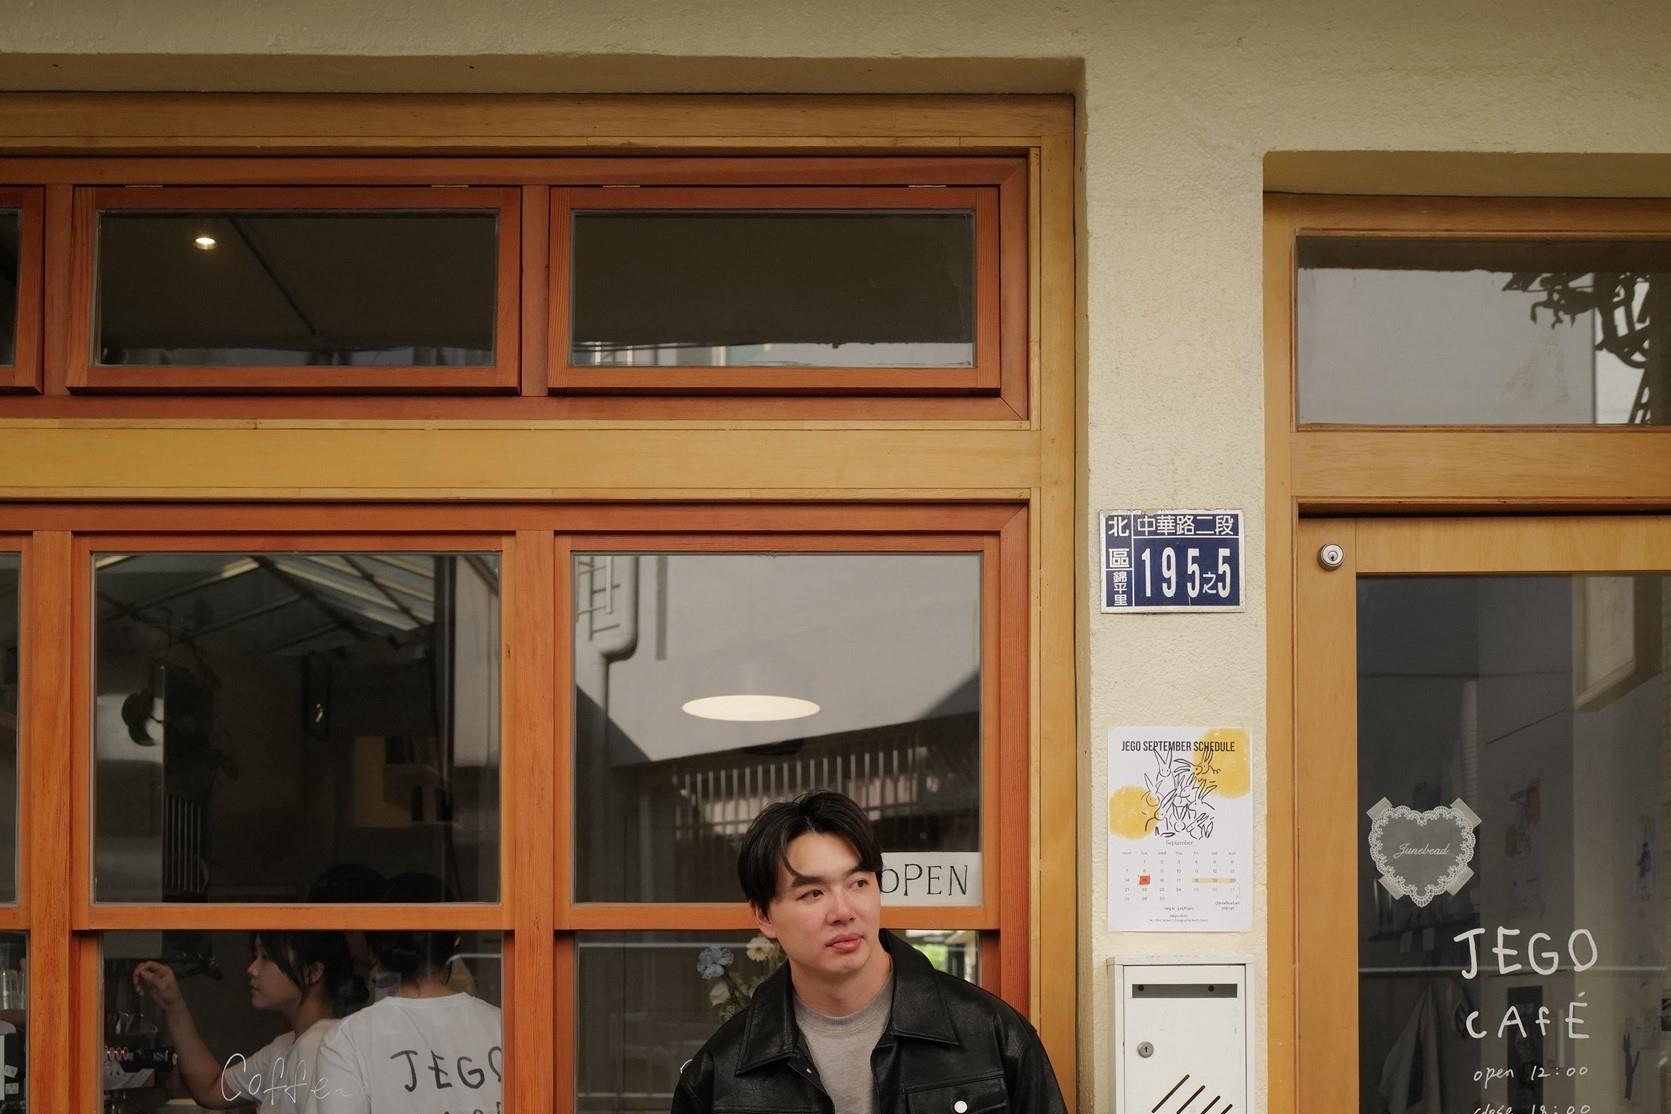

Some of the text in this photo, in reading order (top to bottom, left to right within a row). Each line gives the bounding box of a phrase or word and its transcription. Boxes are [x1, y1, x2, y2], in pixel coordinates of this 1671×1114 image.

[1108, 516, 1130, 568] 北區
[1137, 515, 1234, 536] 中華路二段
[1113, 571, 1128, 606] 錦平里
[1141, 547, 1231, 598] 195之5
[1121, 741, 1236, 752] JEGO SEPTEMBER SCHEDULE
[1453, 926, 1598, 979] JEGO
[1473, 1066, 1589, 1089] open 12:00
